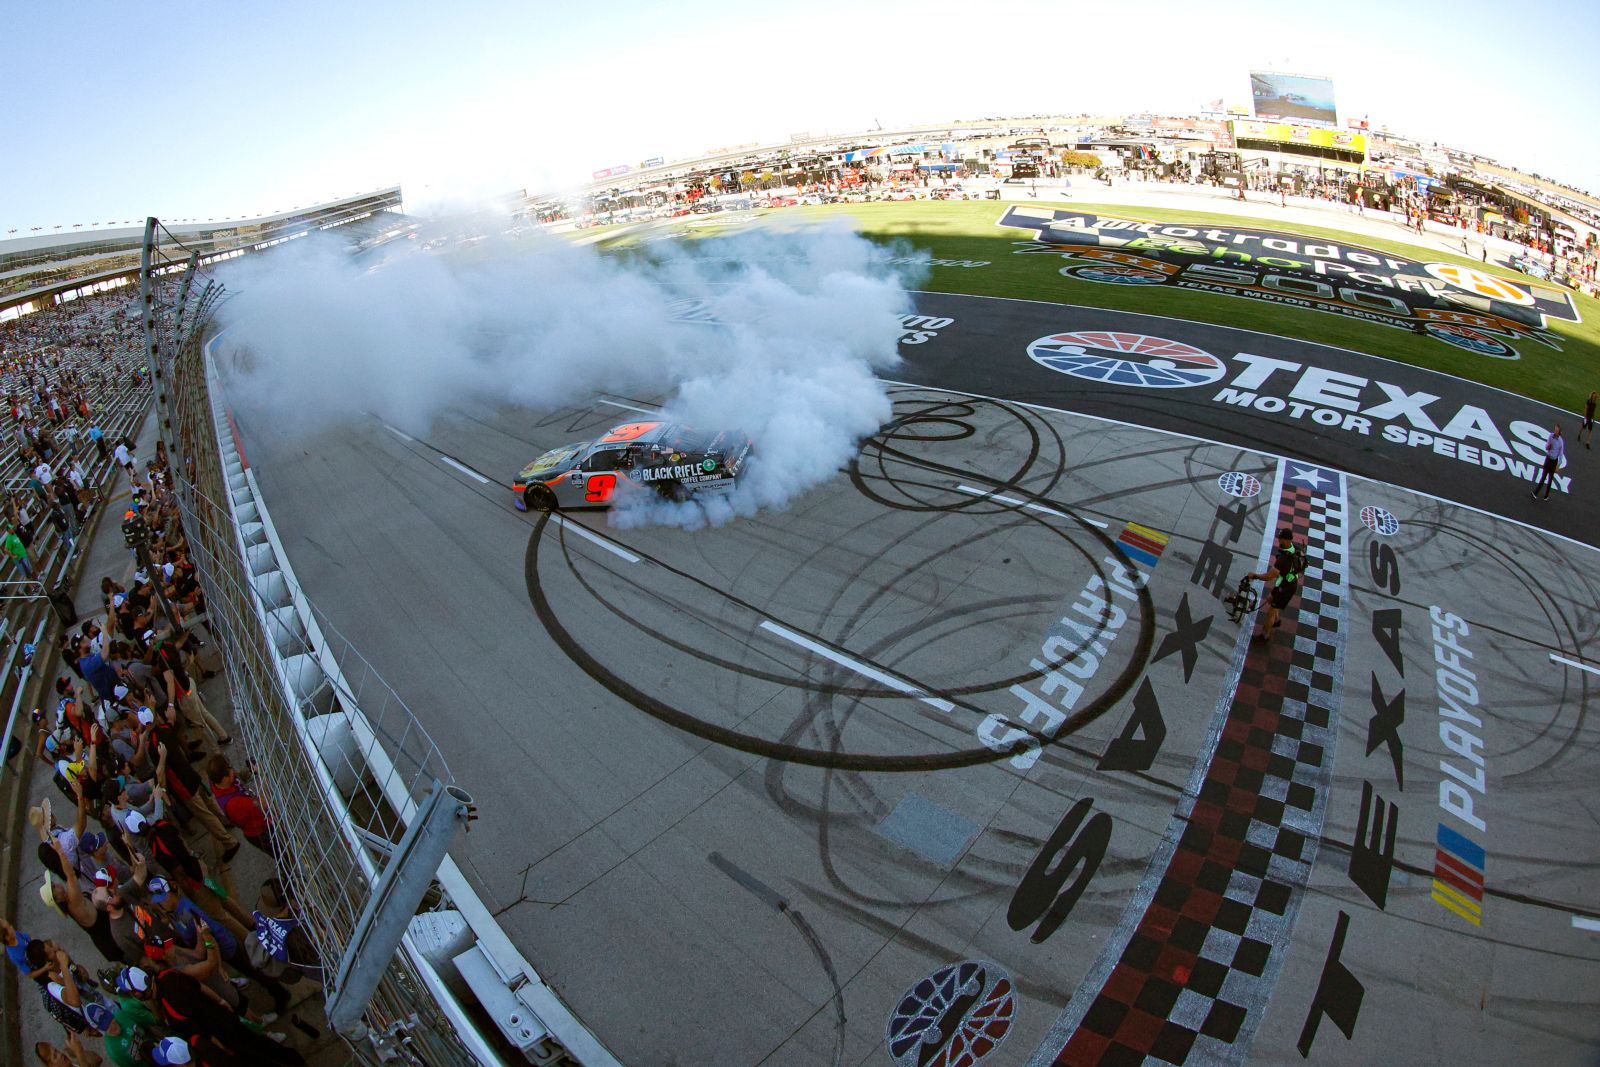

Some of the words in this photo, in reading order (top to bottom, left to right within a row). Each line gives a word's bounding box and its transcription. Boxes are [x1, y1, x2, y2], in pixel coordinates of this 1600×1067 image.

[1042, 217, 1407, 270] Autotrader
[1180, 263, 1411, 316] 500
[1215, 260, 1384, 292] AUTOMOTIVE
[1176, 280, 1237, 294] TEXAS
[1243, 290, 1313, 307] MOTOR
[1316, 303, 1416, 329] SPEEDWAY
[601, 421, 663, 443] 9
[1214, 388, 1372, 436] MOTOR
[1232, 352, 1568, 470] TEXAS
[584, 474, 617, 502] 9
[642, 466, 674, 481] BLACK
[674, 463, 704, 478] RIFLE
[699, 473, 722, 482] COMPANY
[976, 556, 1150, 769] PLAYOFFS
[1007, 503, 1247, 944] TEXAS
[1429, 605, 1488, 832] PLAYOFFS
[1296, 540, 1406, 1059] TEXAS
